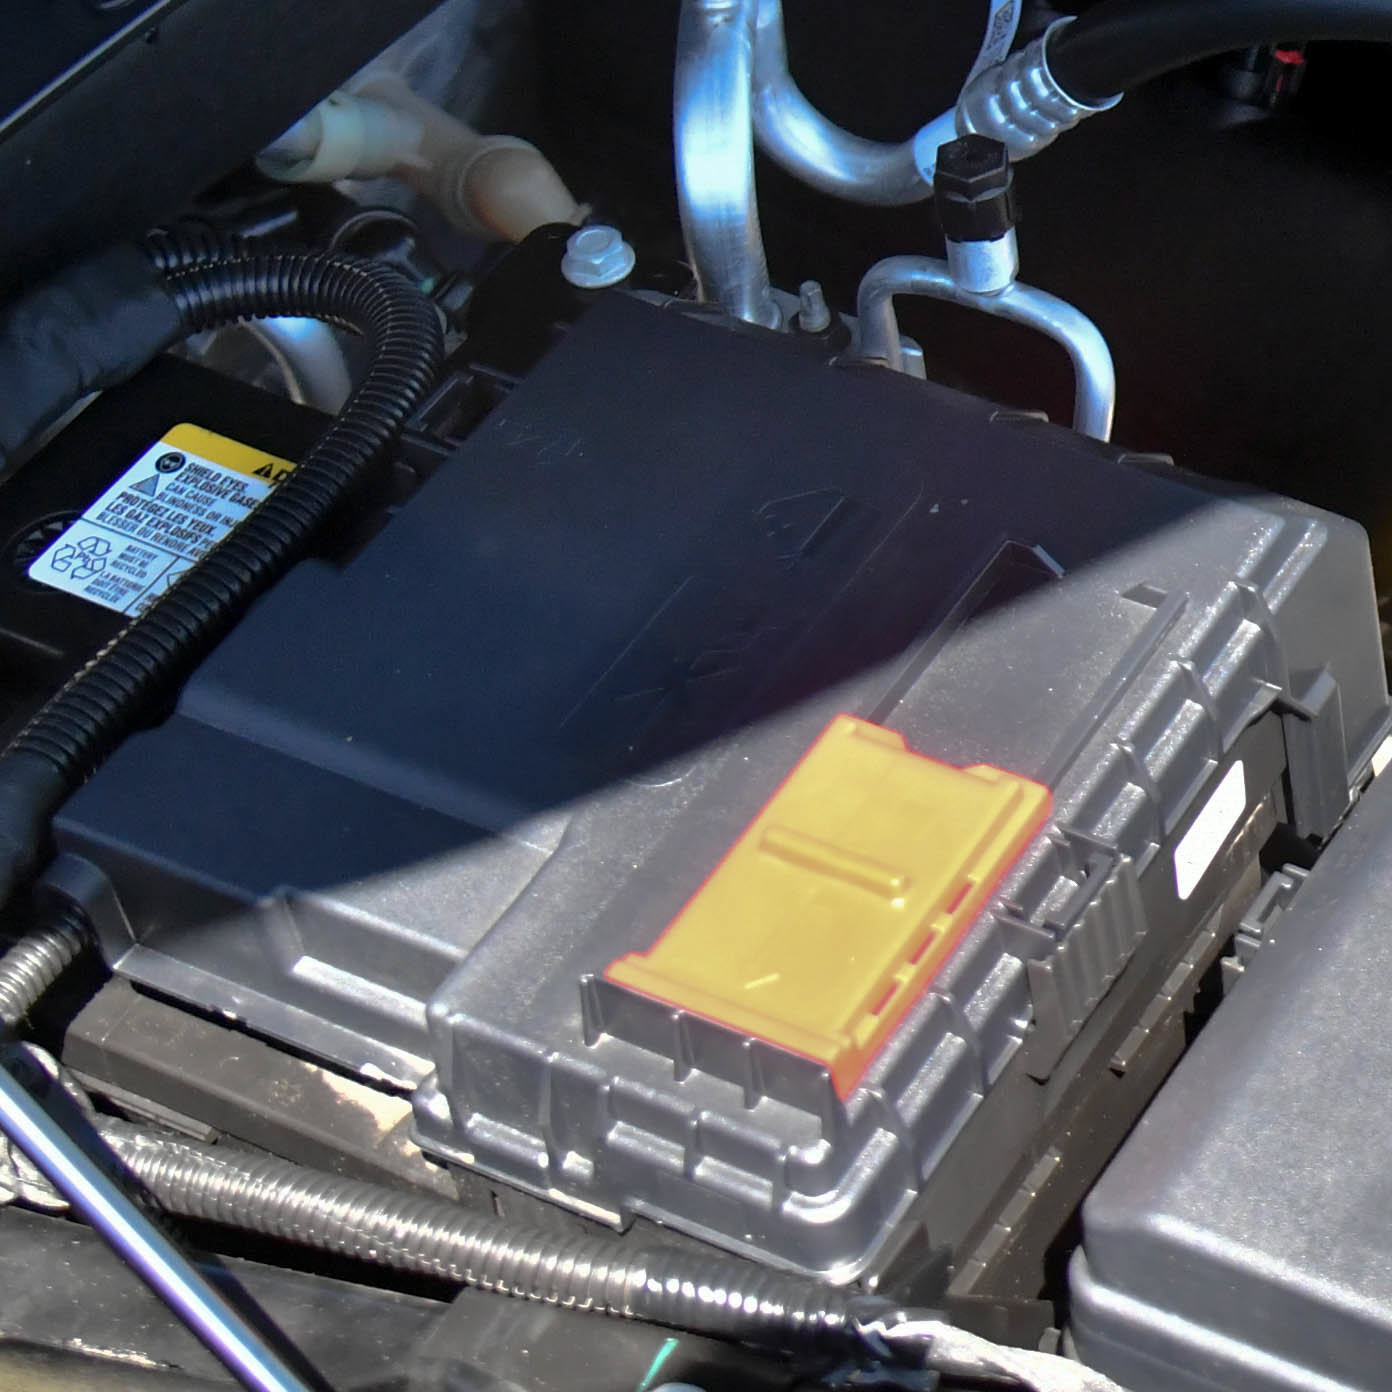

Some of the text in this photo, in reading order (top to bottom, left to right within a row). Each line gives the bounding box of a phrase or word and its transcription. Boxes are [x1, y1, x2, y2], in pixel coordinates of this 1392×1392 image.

[176, 472, 232, 498] EXPLOSIVE
[185, 463, 224, 482] SHIELD
[156, 492, 208, 516] BLINDNESS
[206, 511, 222, 521] OR
[166, 483, 217, 506] CAN CAUSE
[106, 502, 128, 515] LES
[146, 518, 202, 544] EXPLOSIFS
[166, 511, 190, 524] LES
[96, 512, 139, 533] BLESSER
[137, 528, 154, 538] OU
[151, 533, 190, 552] RENDRE
